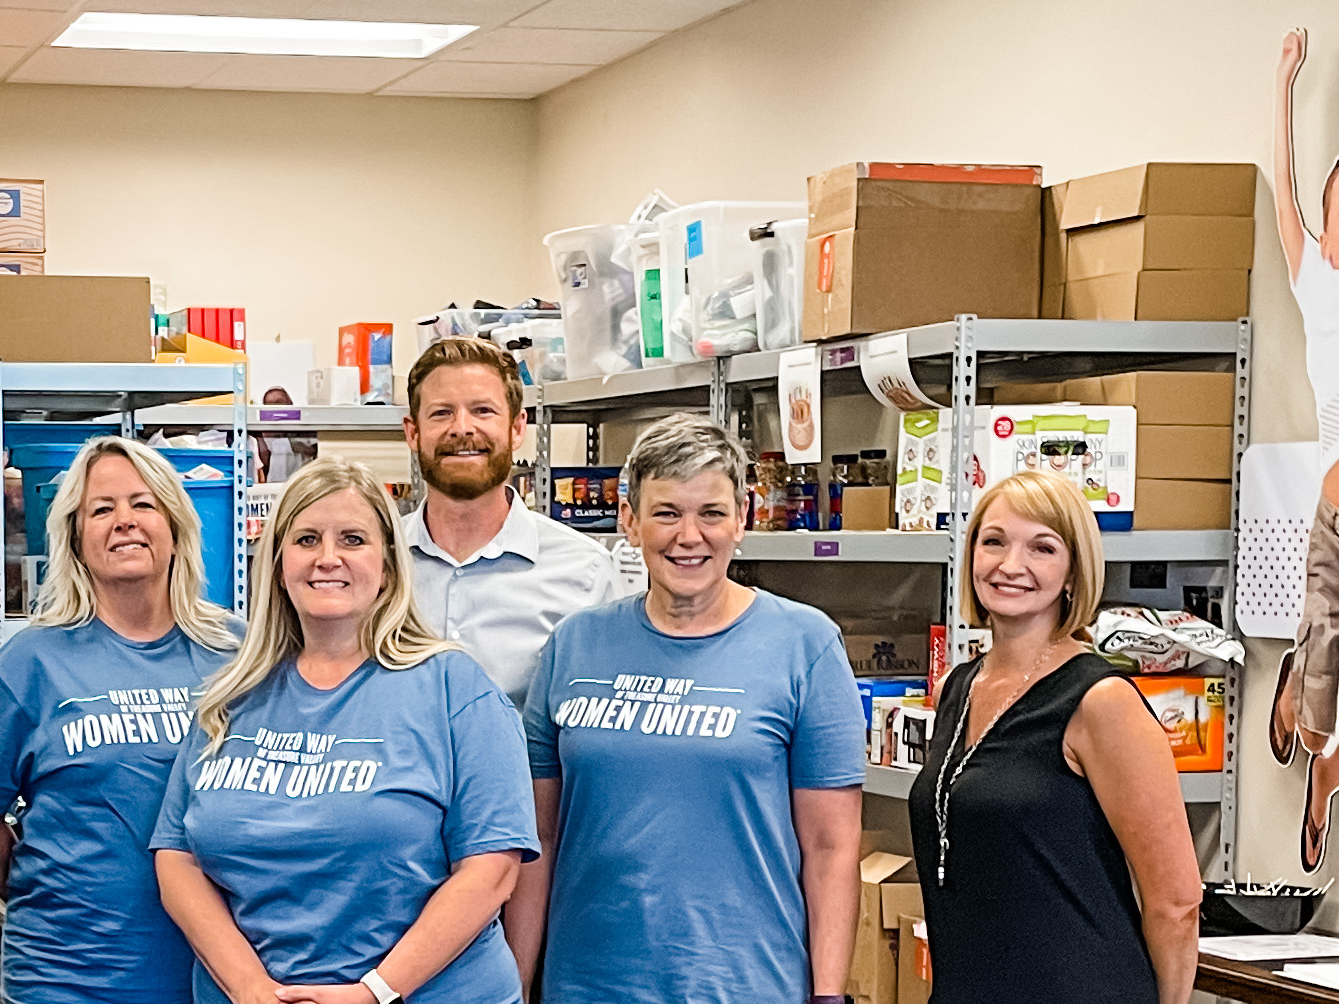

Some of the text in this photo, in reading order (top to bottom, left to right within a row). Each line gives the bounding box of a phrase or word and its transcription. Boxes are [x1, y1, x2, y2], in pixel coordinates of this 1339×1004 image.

[575, 509, 603, 517] CLASSIC
[109, 687, 189, 705] UNITED WAY
[613, 674, 694, 696] UNITED WAY
[1207, 682, 1225, 694] 45
[556, 697, 737, 739] WOMEN UNITED
[62, 713, 159, 756] WOMEN
[255, 728, 337, 753] UNITED WAY
[195, 756, 377, 798] WOMEN UNITED
